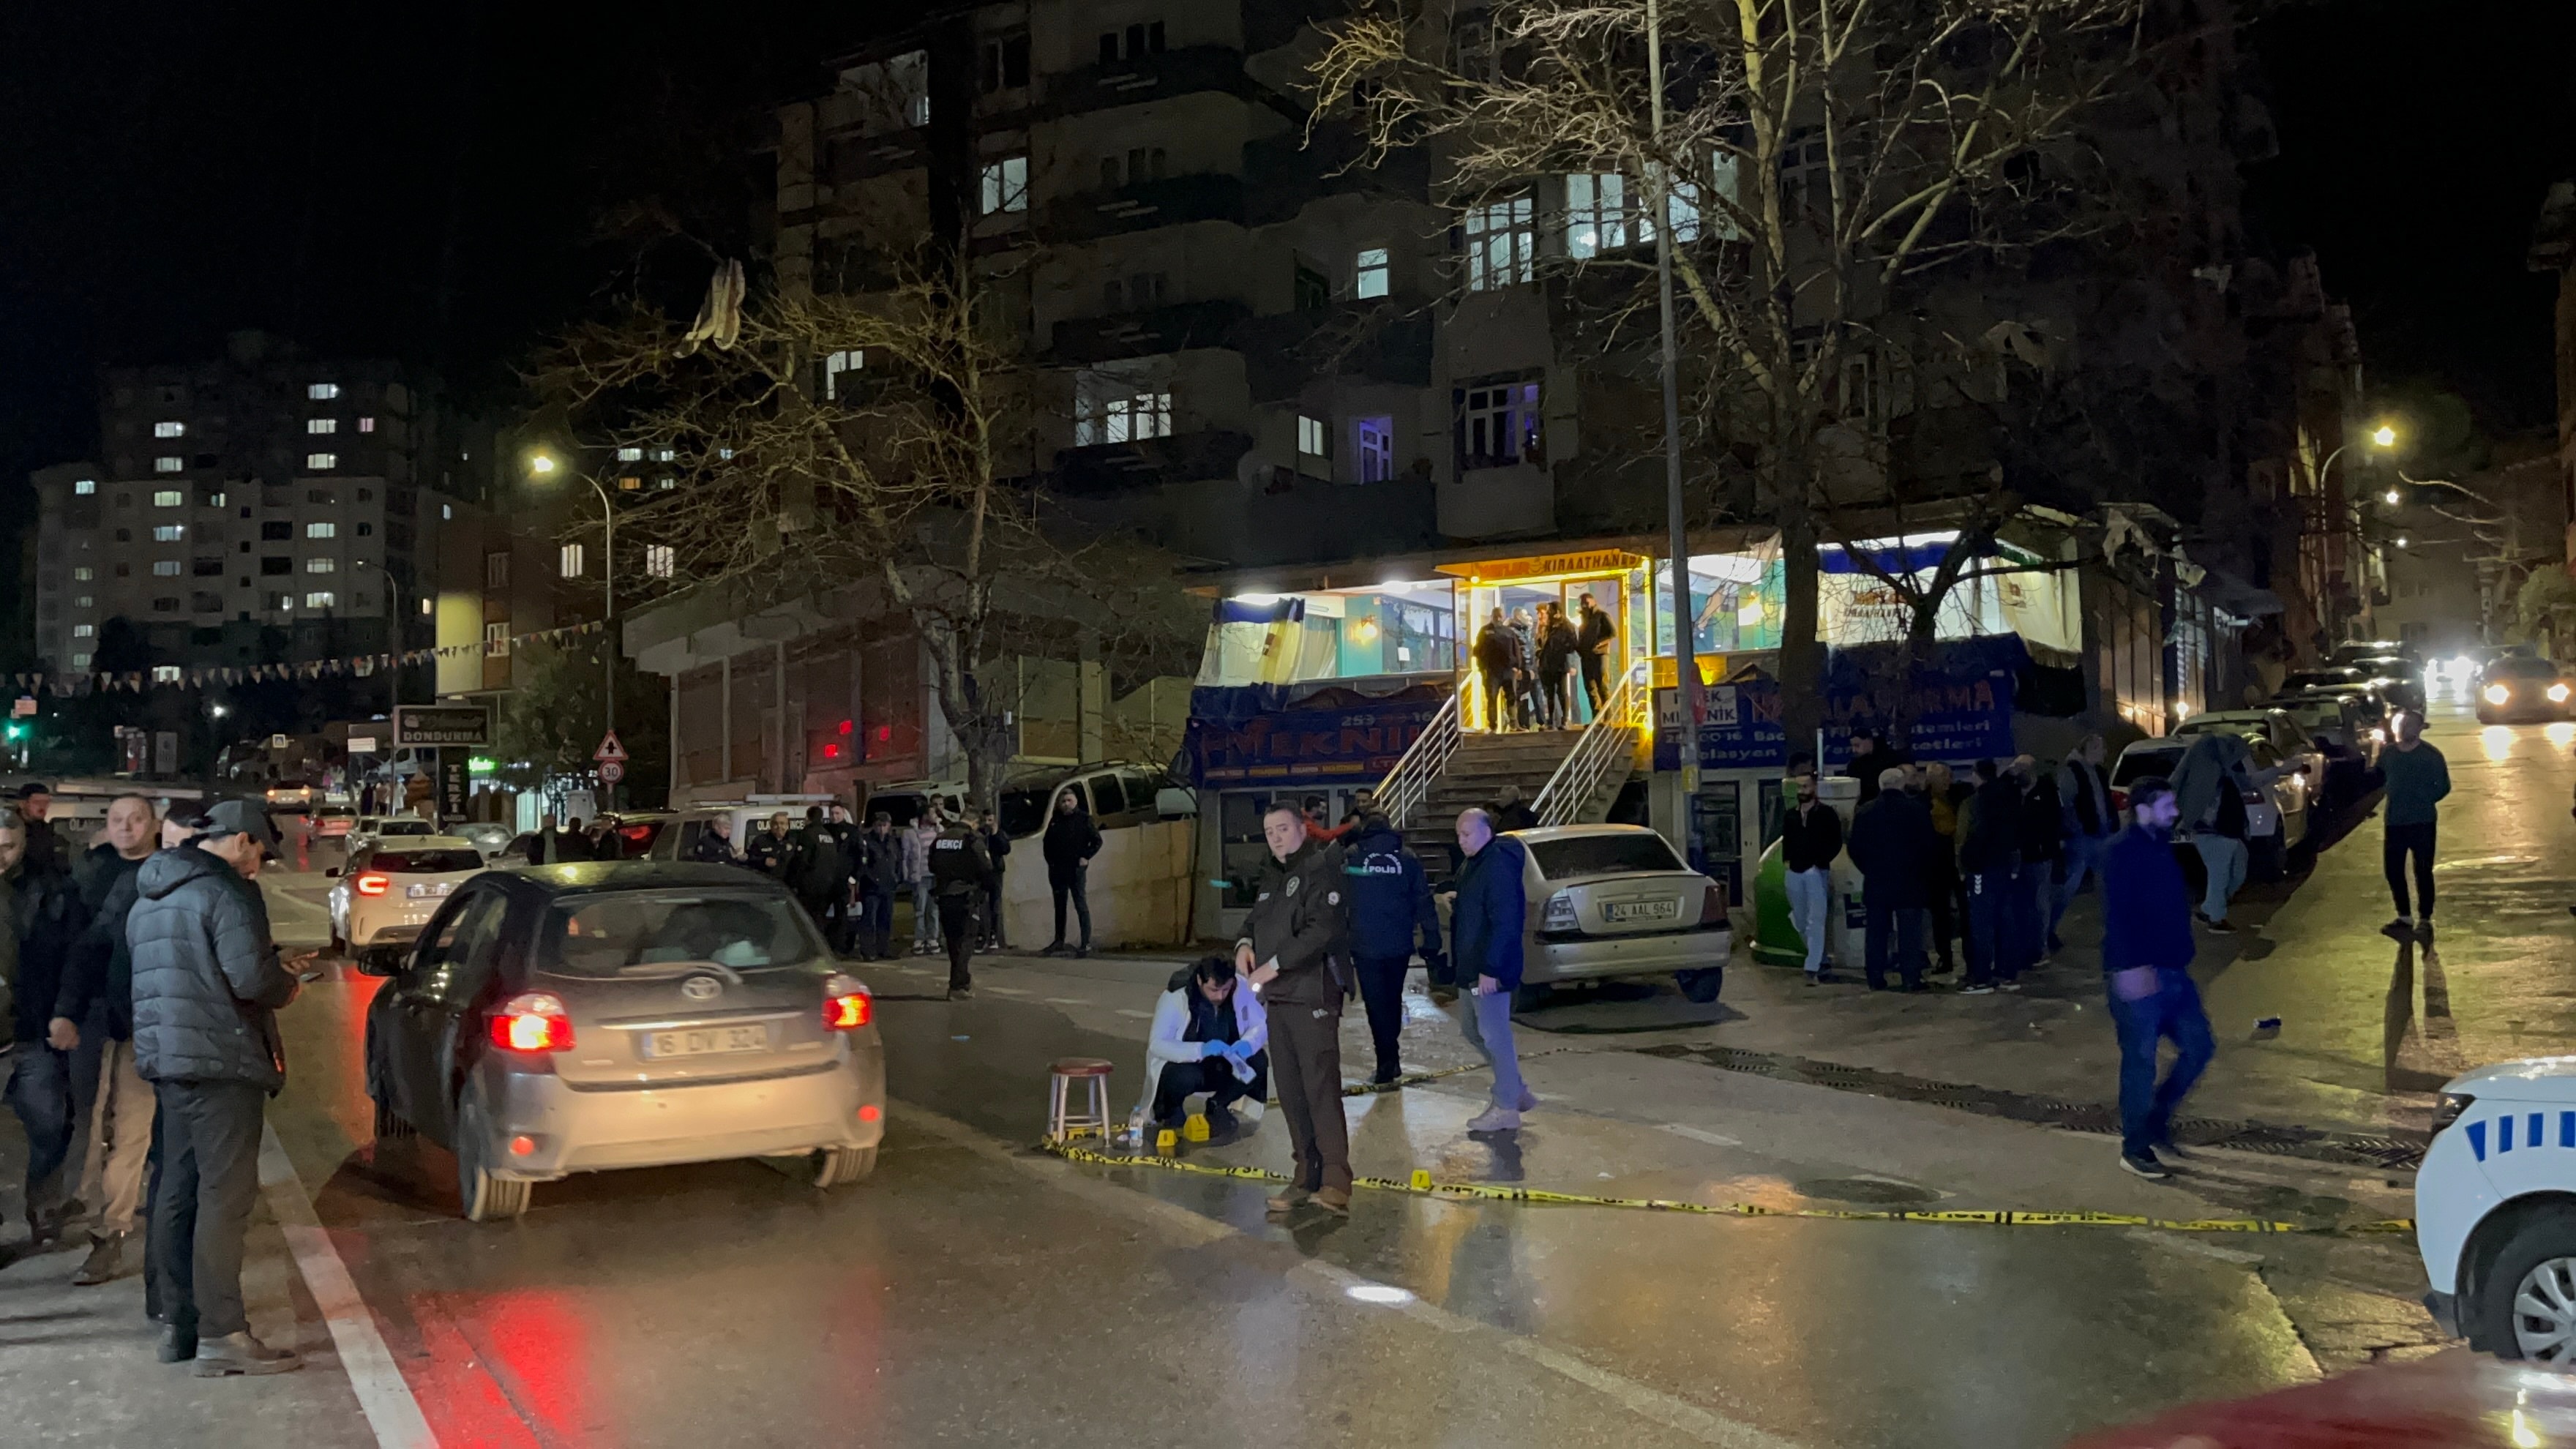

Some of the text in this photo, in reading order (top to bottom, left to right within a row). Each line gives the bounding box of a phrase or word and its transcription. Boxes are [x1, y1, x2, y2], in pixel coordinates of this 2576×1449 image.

[403, 731, 484, 741] DONDURMA
[604, 767, 618, 777] 30
[1614, 905, 1627, 917] 24
[1632, 904, 1651, 916] AAL
